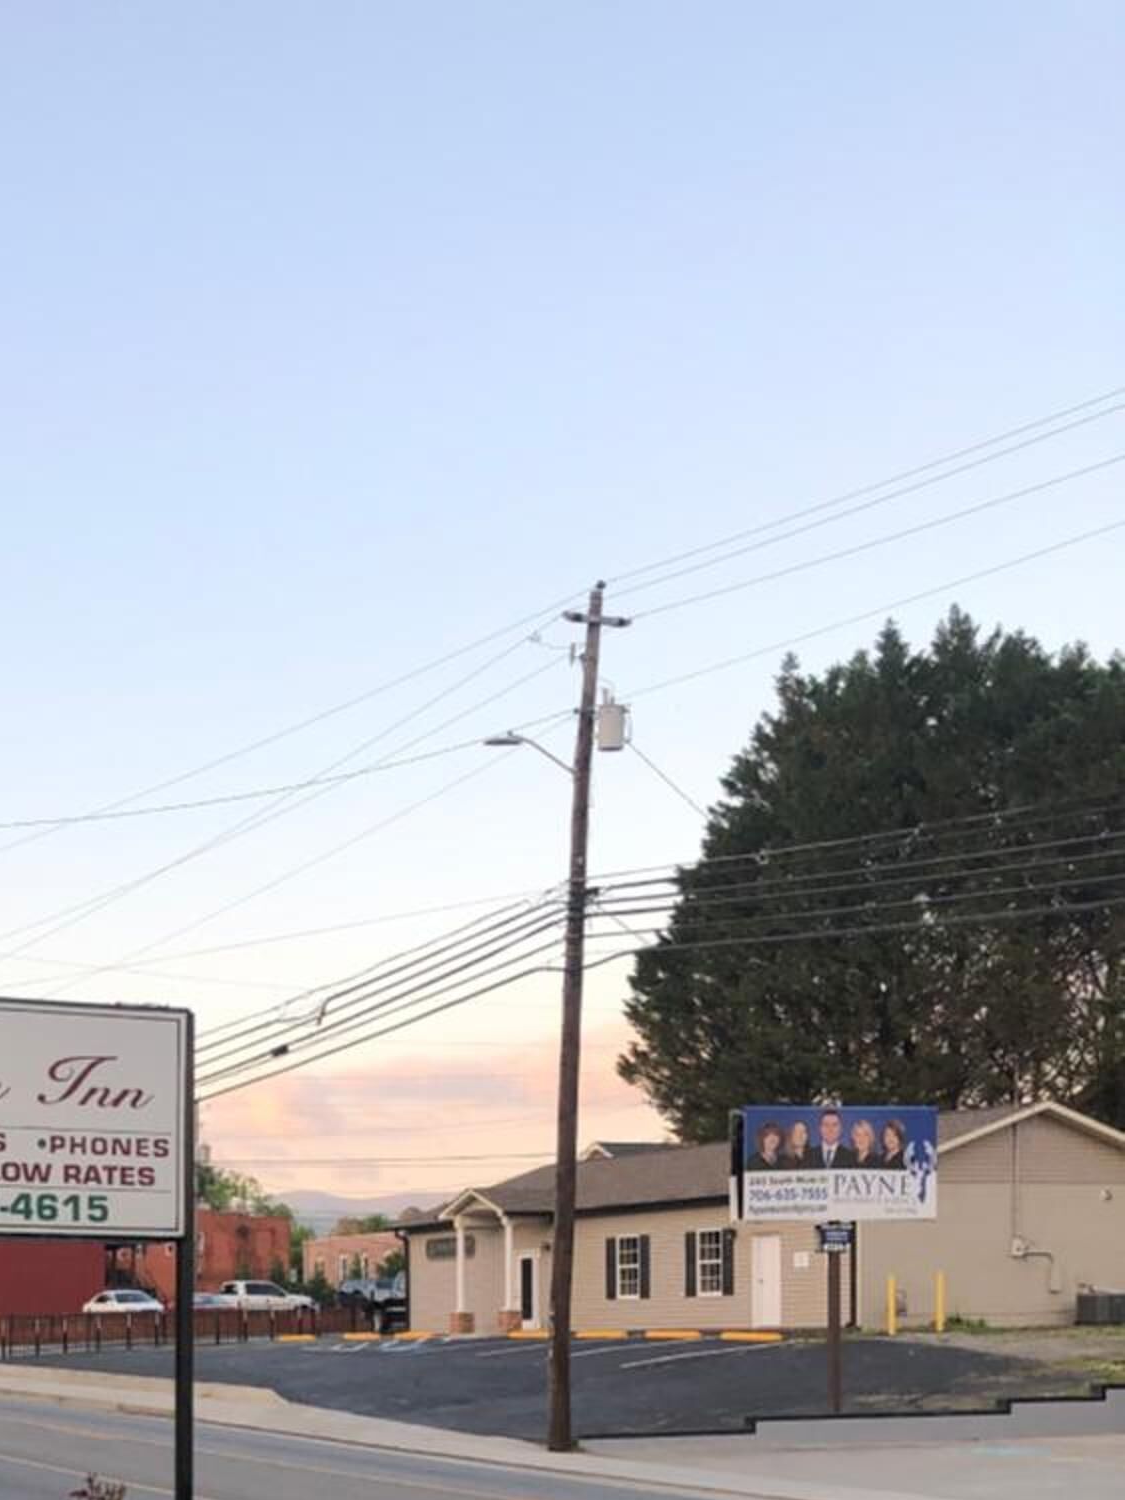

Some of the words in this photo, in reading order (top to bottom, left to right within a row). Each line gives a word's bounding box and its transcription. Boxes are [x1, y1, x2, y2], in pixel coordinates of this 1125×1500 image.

[37, 1055, 154, 1110] Inn
[50, 1135, 169, 1158] PHONES
[63, 1164, 156, 1187] RATES
[834, 1174, 911, 1196] PAYNE
